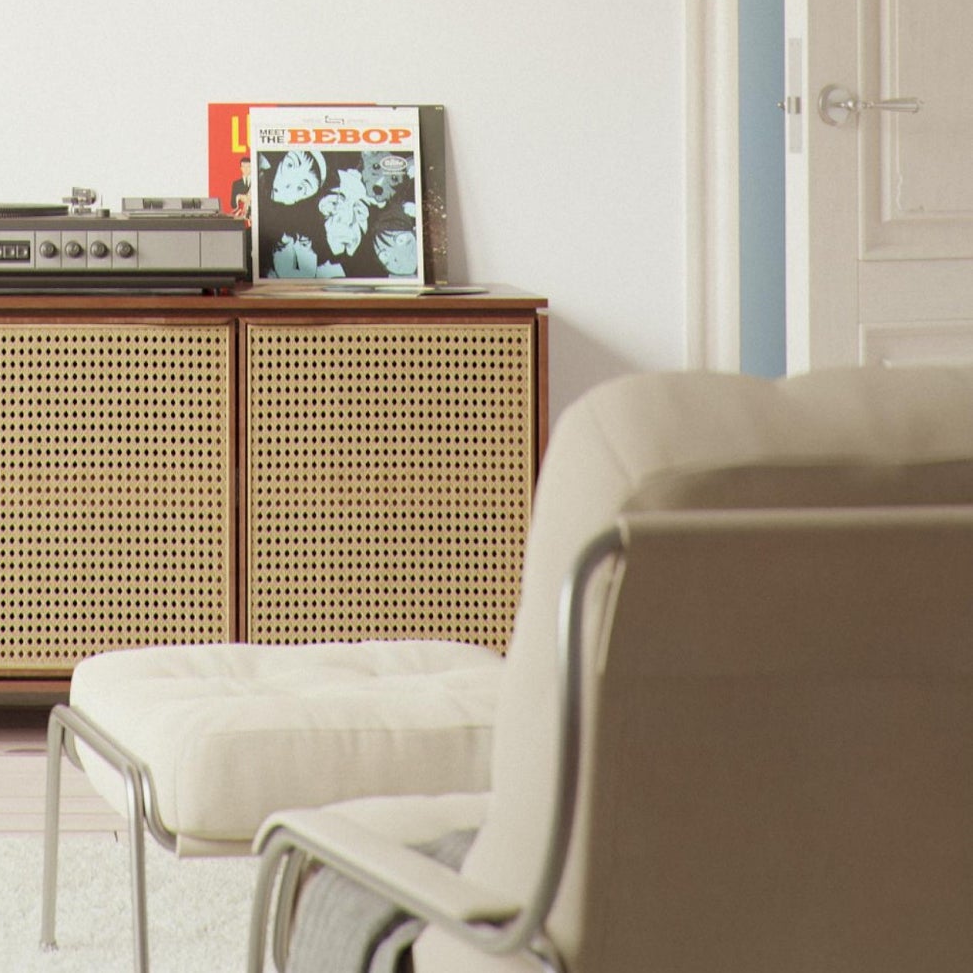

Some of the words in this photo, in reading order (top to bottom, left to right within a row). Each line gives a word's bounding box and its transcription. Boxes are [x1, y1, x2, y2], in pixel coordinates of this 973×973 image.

[259, 128, 285, 136] MEET
[259, 136, 285, 144] THE
[287, 129, 412, 145] BEBOP
